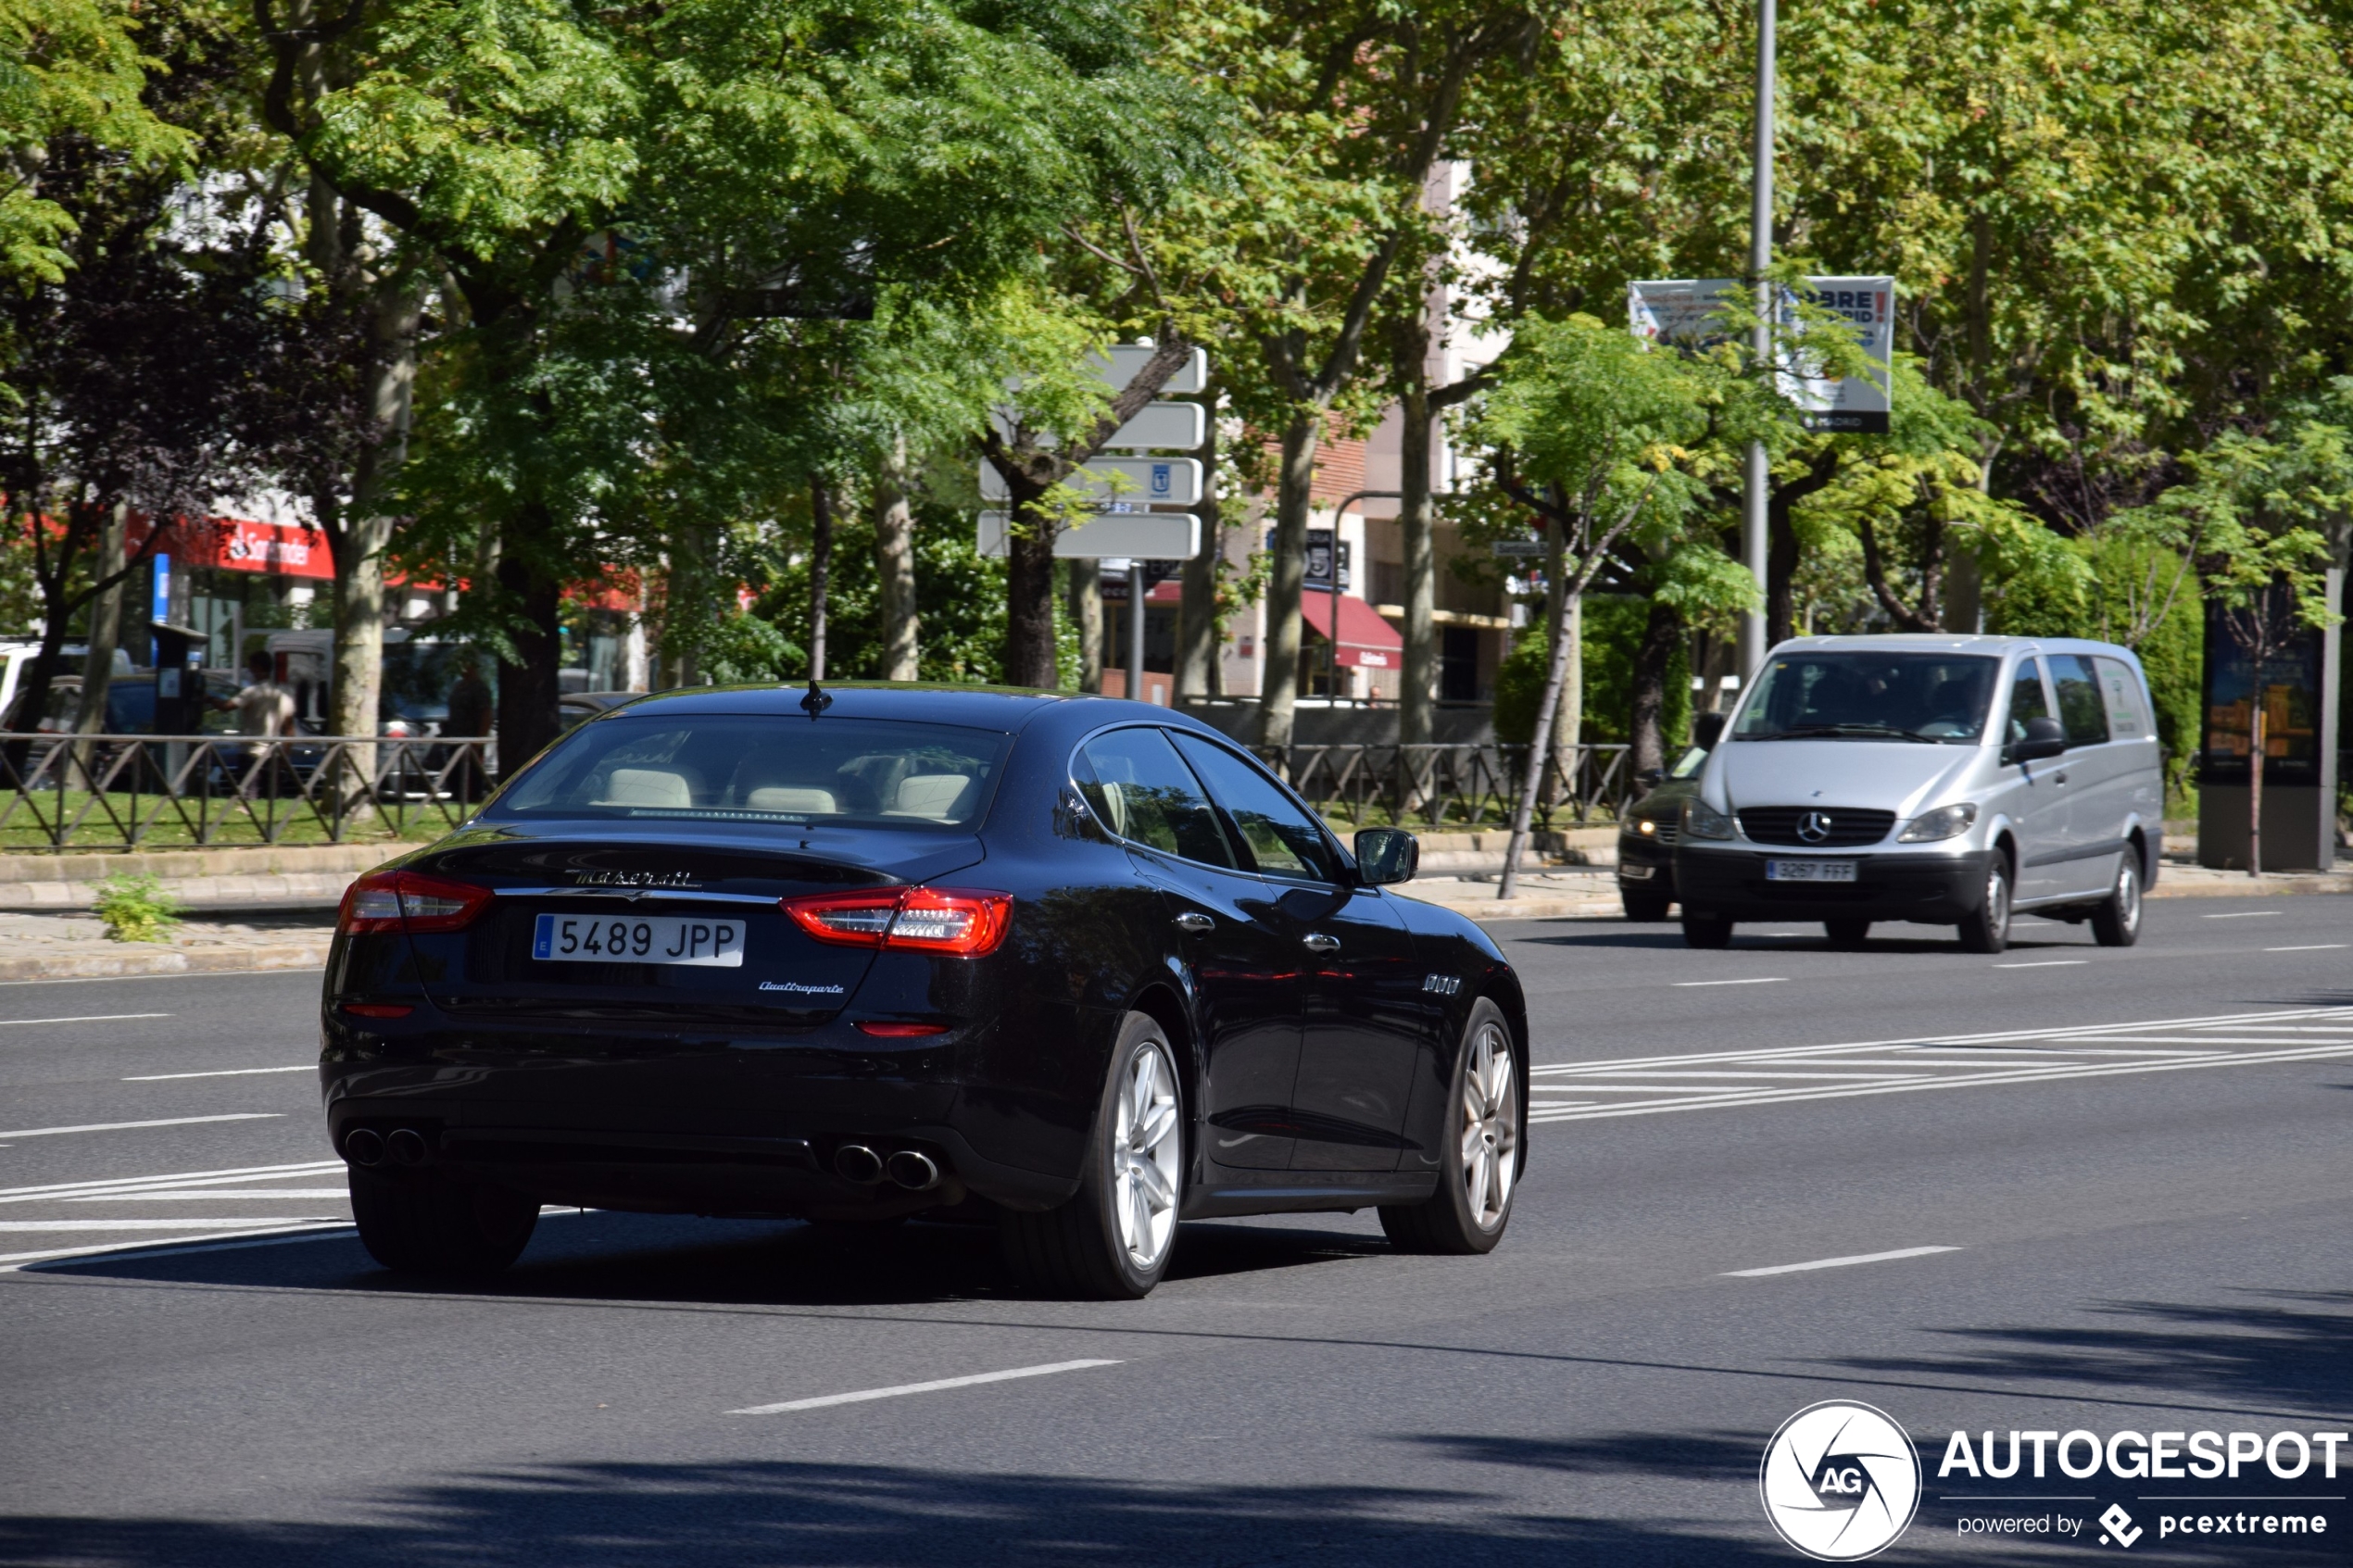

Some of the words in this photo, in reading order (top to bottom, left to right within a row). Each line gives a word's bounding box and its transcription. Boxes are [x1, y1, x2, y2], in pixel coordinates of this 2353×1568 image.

[245, 532, 309, 566] Santander
[564, 869, 702, 888] Maserati
[539, 941, 547, 951] E
[560, 921, 652, 957] 5489
[666, 924, 735, 959] JPP
